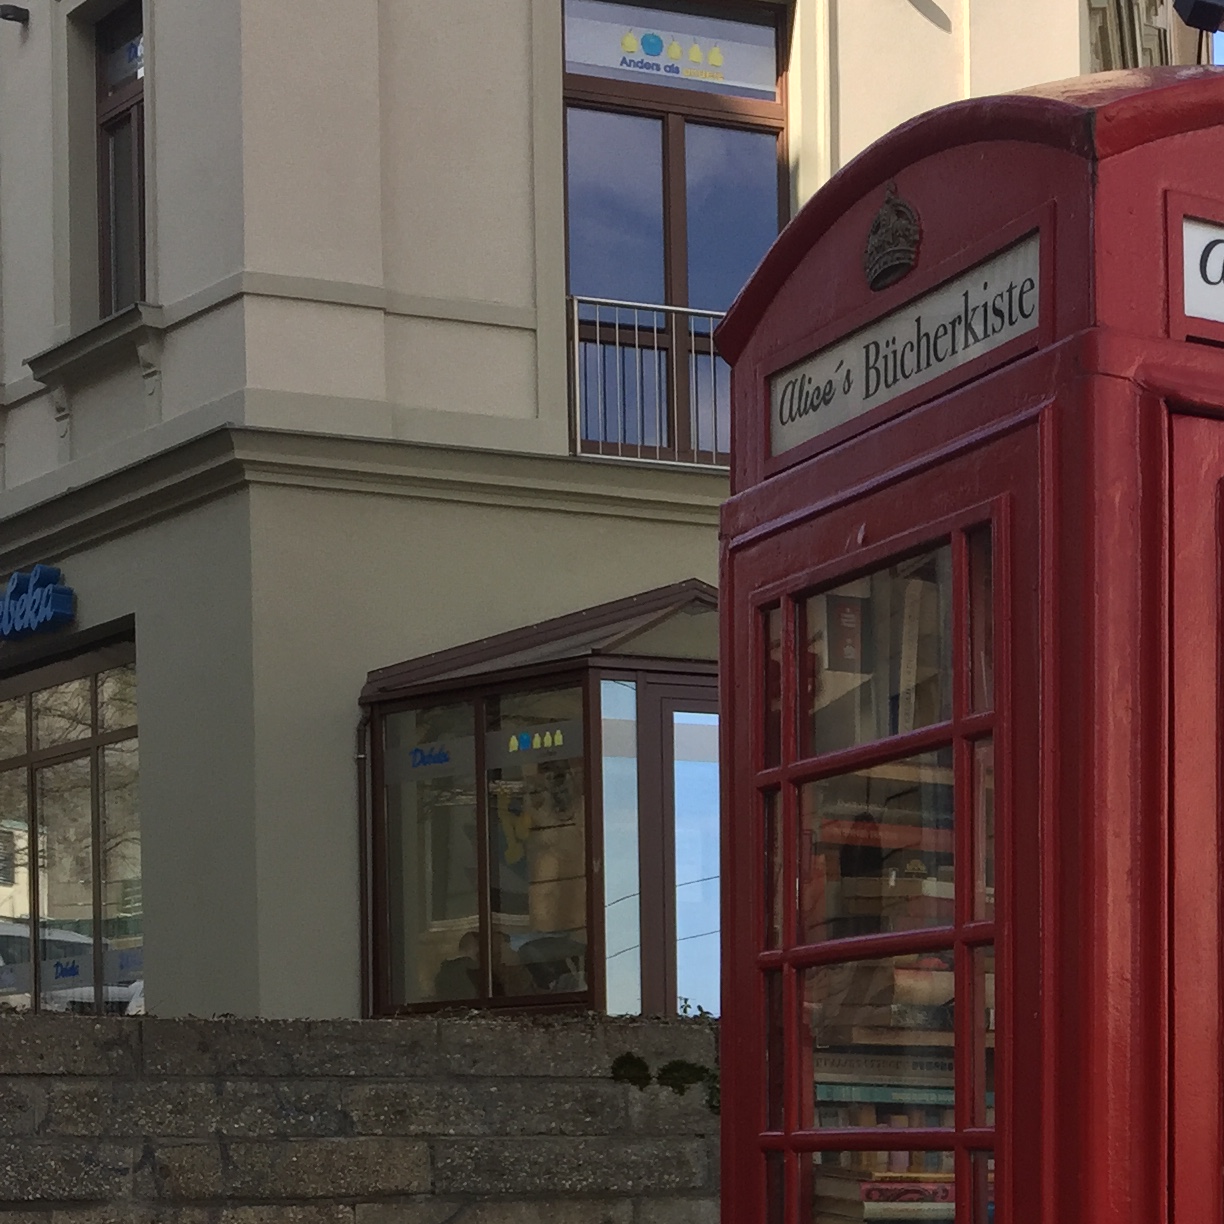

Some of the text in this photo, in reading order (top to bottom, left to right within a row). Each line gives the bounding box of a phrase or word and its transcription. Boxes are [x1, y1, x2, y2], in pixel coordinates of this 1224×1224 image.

[619, 56, 661, 71] Anders
[663, 63, 680, 75] als
[862, 276, 1036, 401] Bücherkiste
